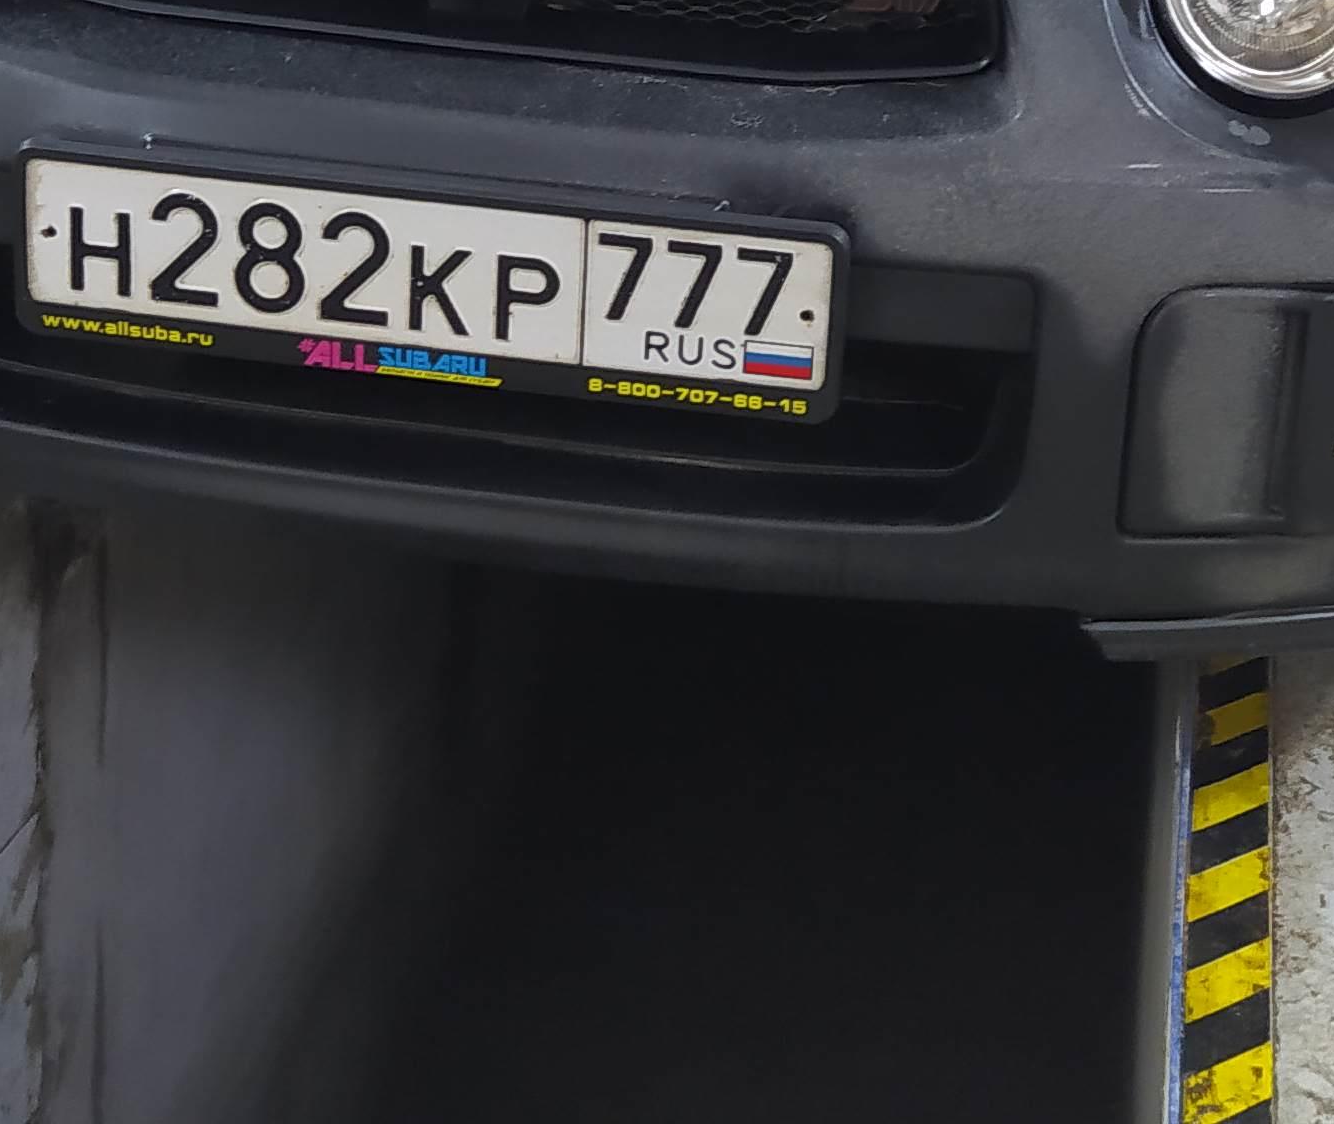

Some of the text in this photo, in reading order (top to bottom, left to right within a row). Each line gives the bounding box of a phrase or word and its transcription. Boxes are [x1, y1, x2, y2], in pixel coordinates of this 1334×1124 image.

[598, 232, 793, 336] 777
[42, 314, 214, 346] www.allsuba.ru
[378, 346, 488, 377] SUBARU
[644, 330, 737, 370] RUS
